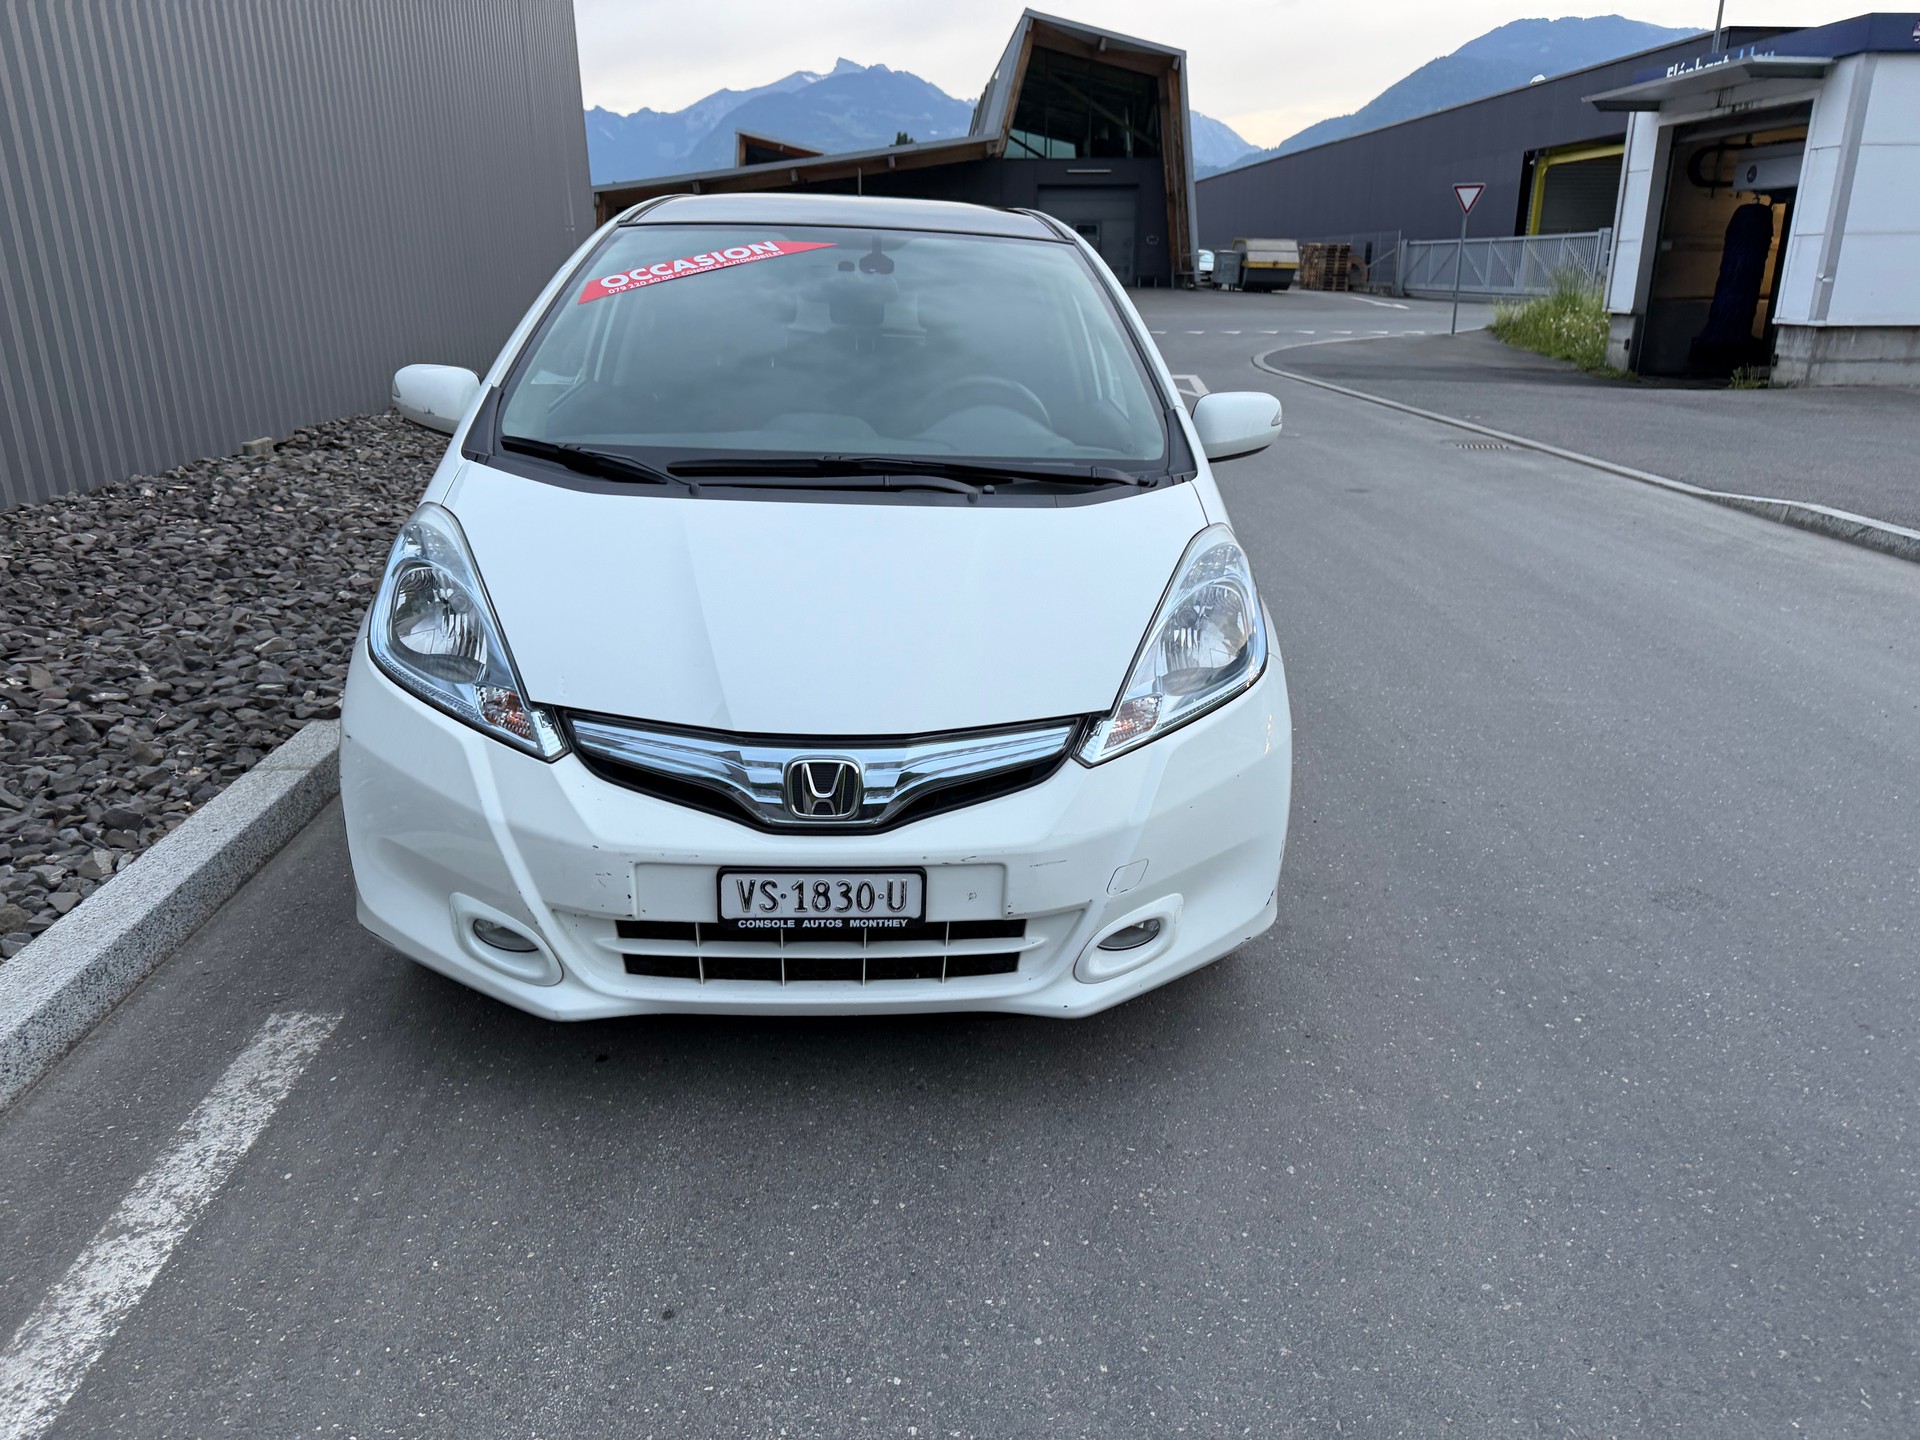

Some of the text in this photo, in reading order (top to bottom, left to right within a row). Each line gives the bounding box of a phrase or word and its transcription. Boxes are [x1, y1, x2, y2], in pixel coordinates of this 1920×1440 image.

[600, 240, 780, 288] OCCASION
[608, 284, 628, 294] 079
[628, 281, 647, 290] 220
[681, 263, 722, 276] CONSOLE
[723, 250, 785, 267] AUTOMOBILES
[737, 918, 908, 929] CONSOLE AUTOS MONTHEY
